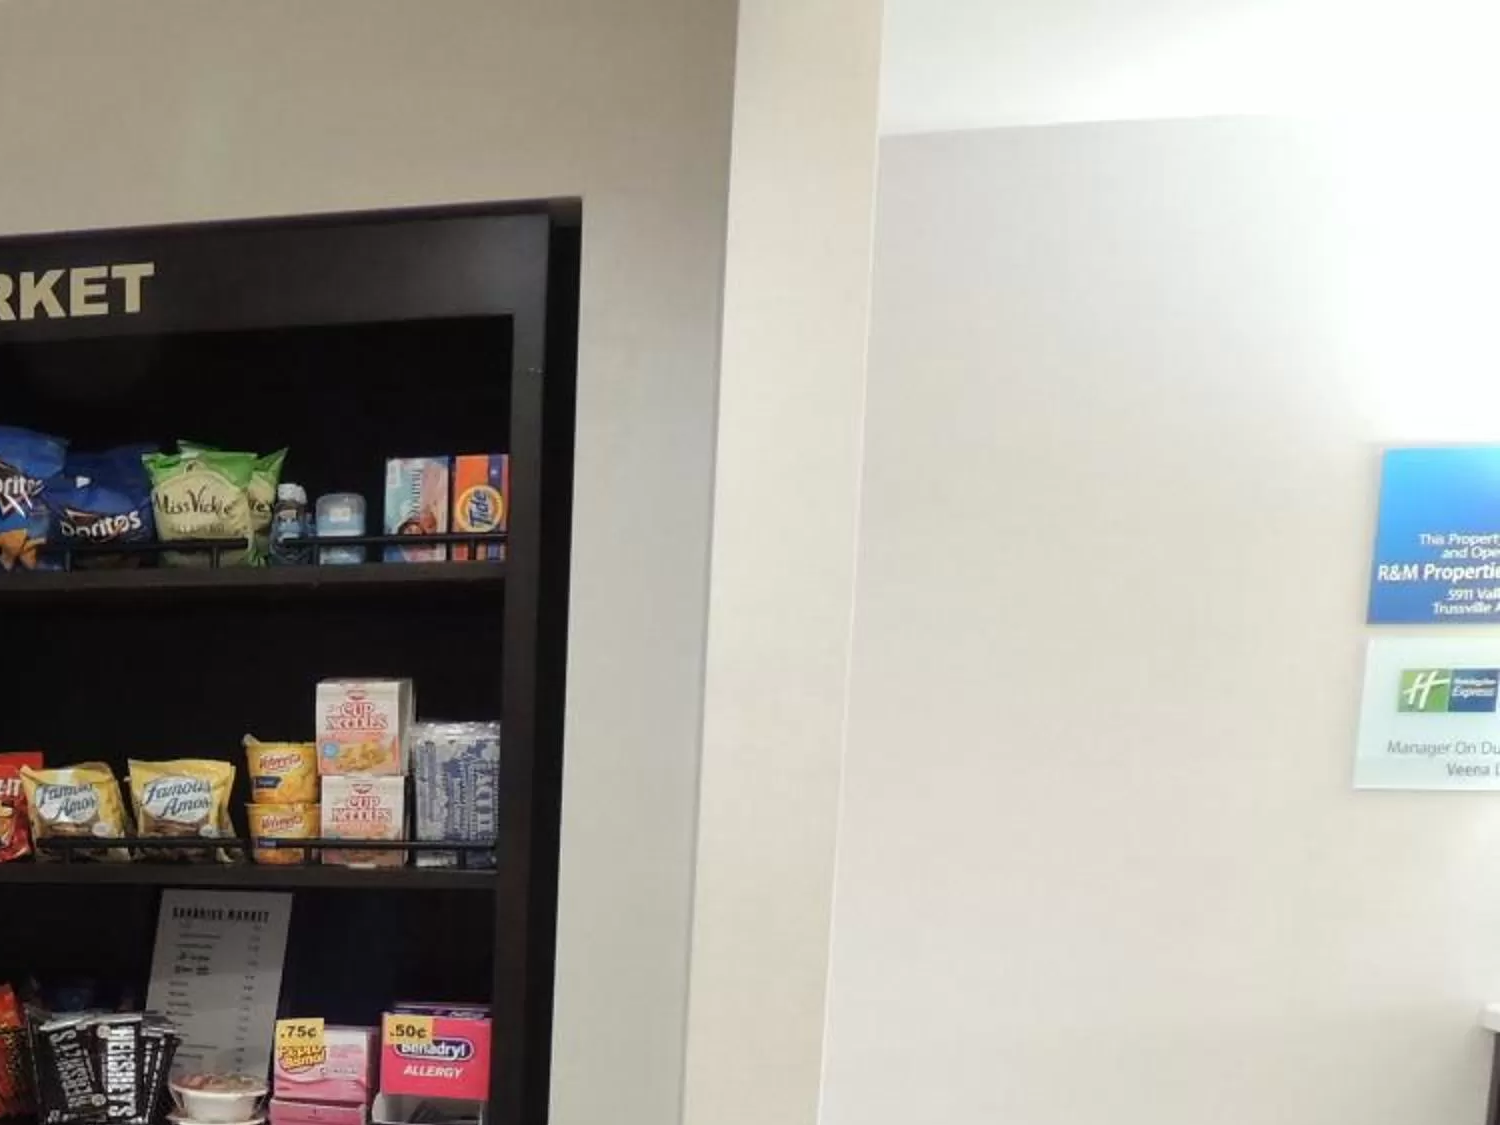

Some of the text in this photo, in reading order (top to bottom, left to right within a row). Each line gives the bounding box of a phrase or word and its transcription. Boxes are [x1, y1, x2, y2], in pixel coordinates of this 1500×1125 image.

[468, 488, 492, 527] Tide
[60, 510, 142, 537] Doritos
[1419, 533, 1445, 545] This
[1441, 547, 1468, 559] and
[1378, 563, 1419, 581] R&M
[1432, 601, 1492, 615] Trussville
[1387, 740, 1451, 758] Manager
[1456, 741, 1476, 754] On
[1446, 763, 1490, 776] Veena
[146, 780, 213, 804] Famous
[160, 797, 213, 818] Amos
[107, 1026, 136, 1116] HERSHEY'S
[404, 1065, 464, 1078] ALLERGY
